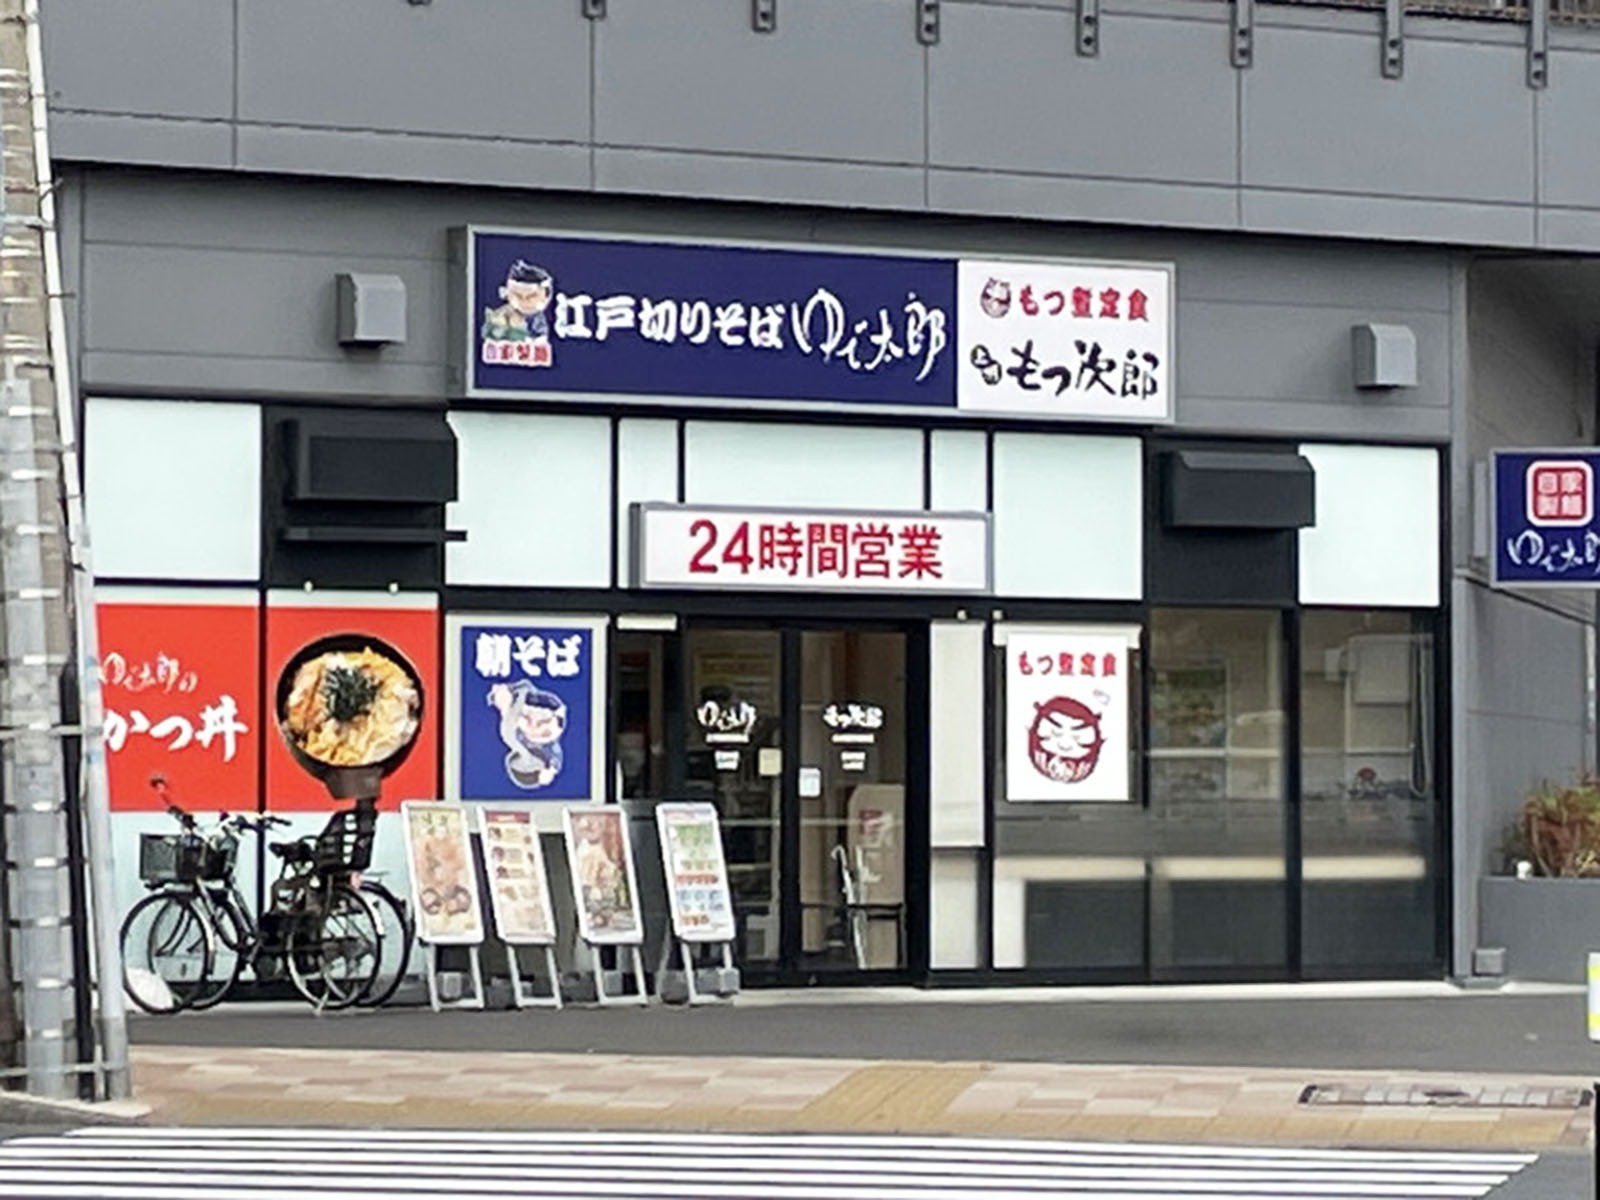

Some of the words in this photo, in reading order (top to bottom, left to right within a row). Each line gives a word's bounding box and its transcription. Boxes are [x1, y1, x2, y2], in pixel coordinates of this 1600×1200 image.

[1006, 339, 1160, 400] もつ次郎
[687, 518, 943, 580] 24時間営業
[475, 632, 582, 677] 朝そば
